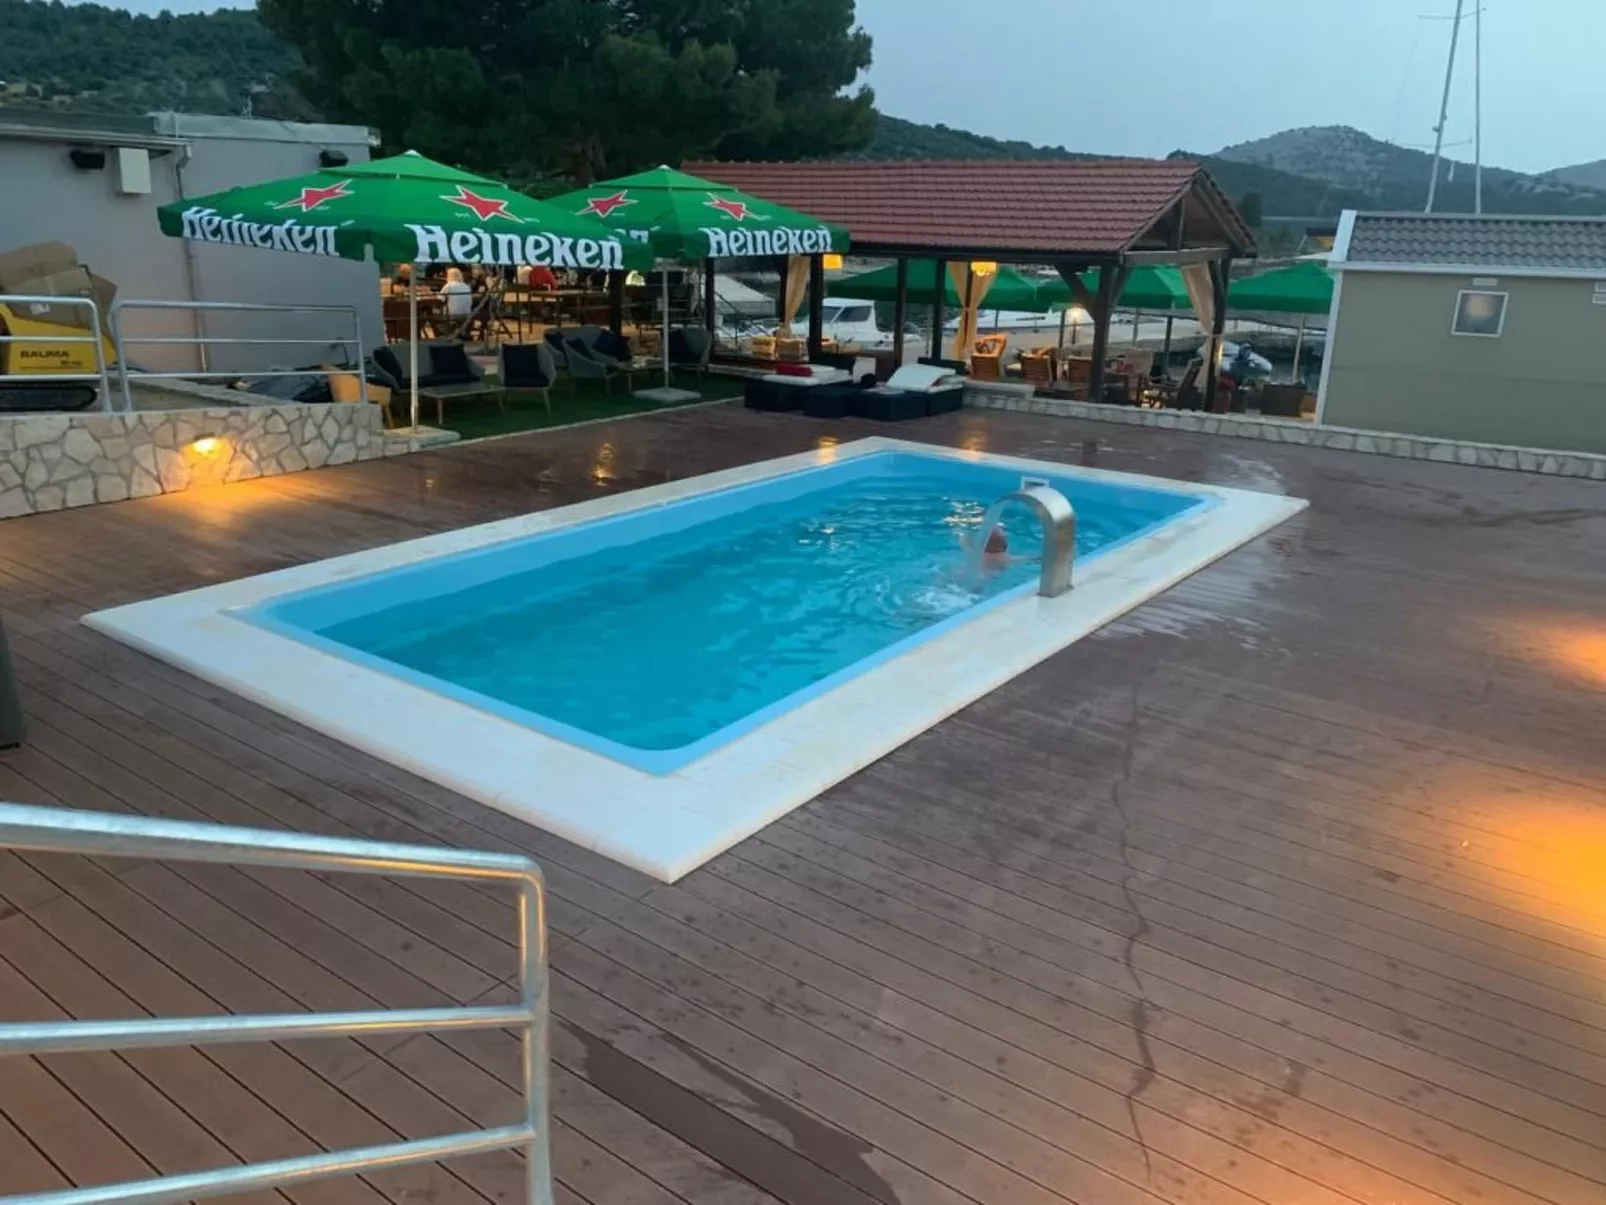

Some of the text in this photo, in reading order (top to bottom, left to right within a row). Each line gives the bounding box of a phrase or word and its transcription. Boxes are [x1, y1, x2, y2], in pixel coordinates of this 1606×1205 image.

[181, 206, 340, 257] Heineken
[403, 224, 624, 269] Heineken
[699, 225, 832, 257] Heineken
